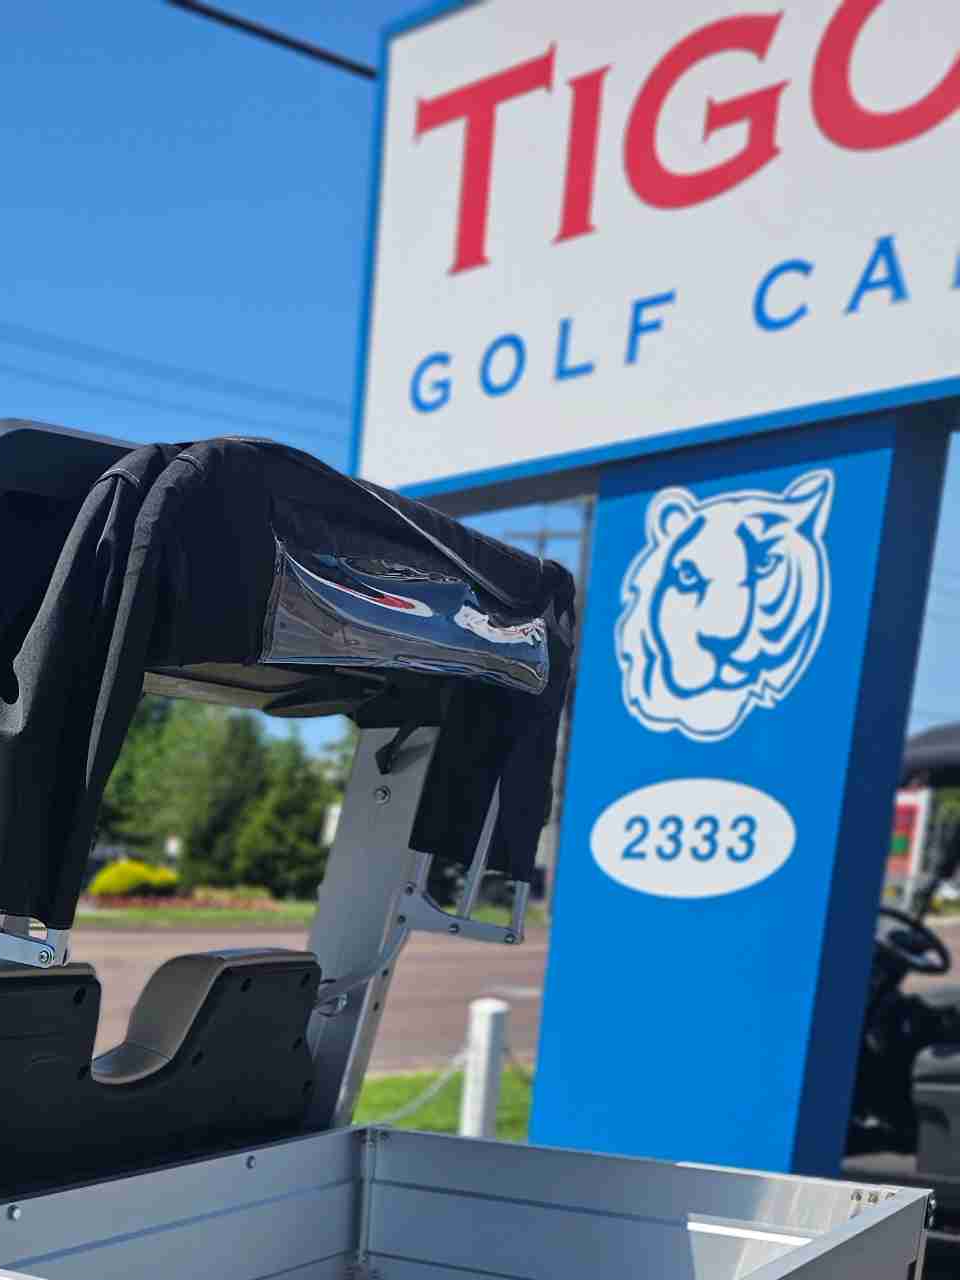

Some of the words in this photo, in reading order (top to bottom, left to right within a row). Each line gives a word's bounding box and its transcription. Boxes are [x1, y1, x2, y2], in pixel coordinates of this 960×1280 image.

[409, 289, 676, 414] GOLF
[752, 234, 960, 333] CA
[621, 814, 759, 863] 2333
